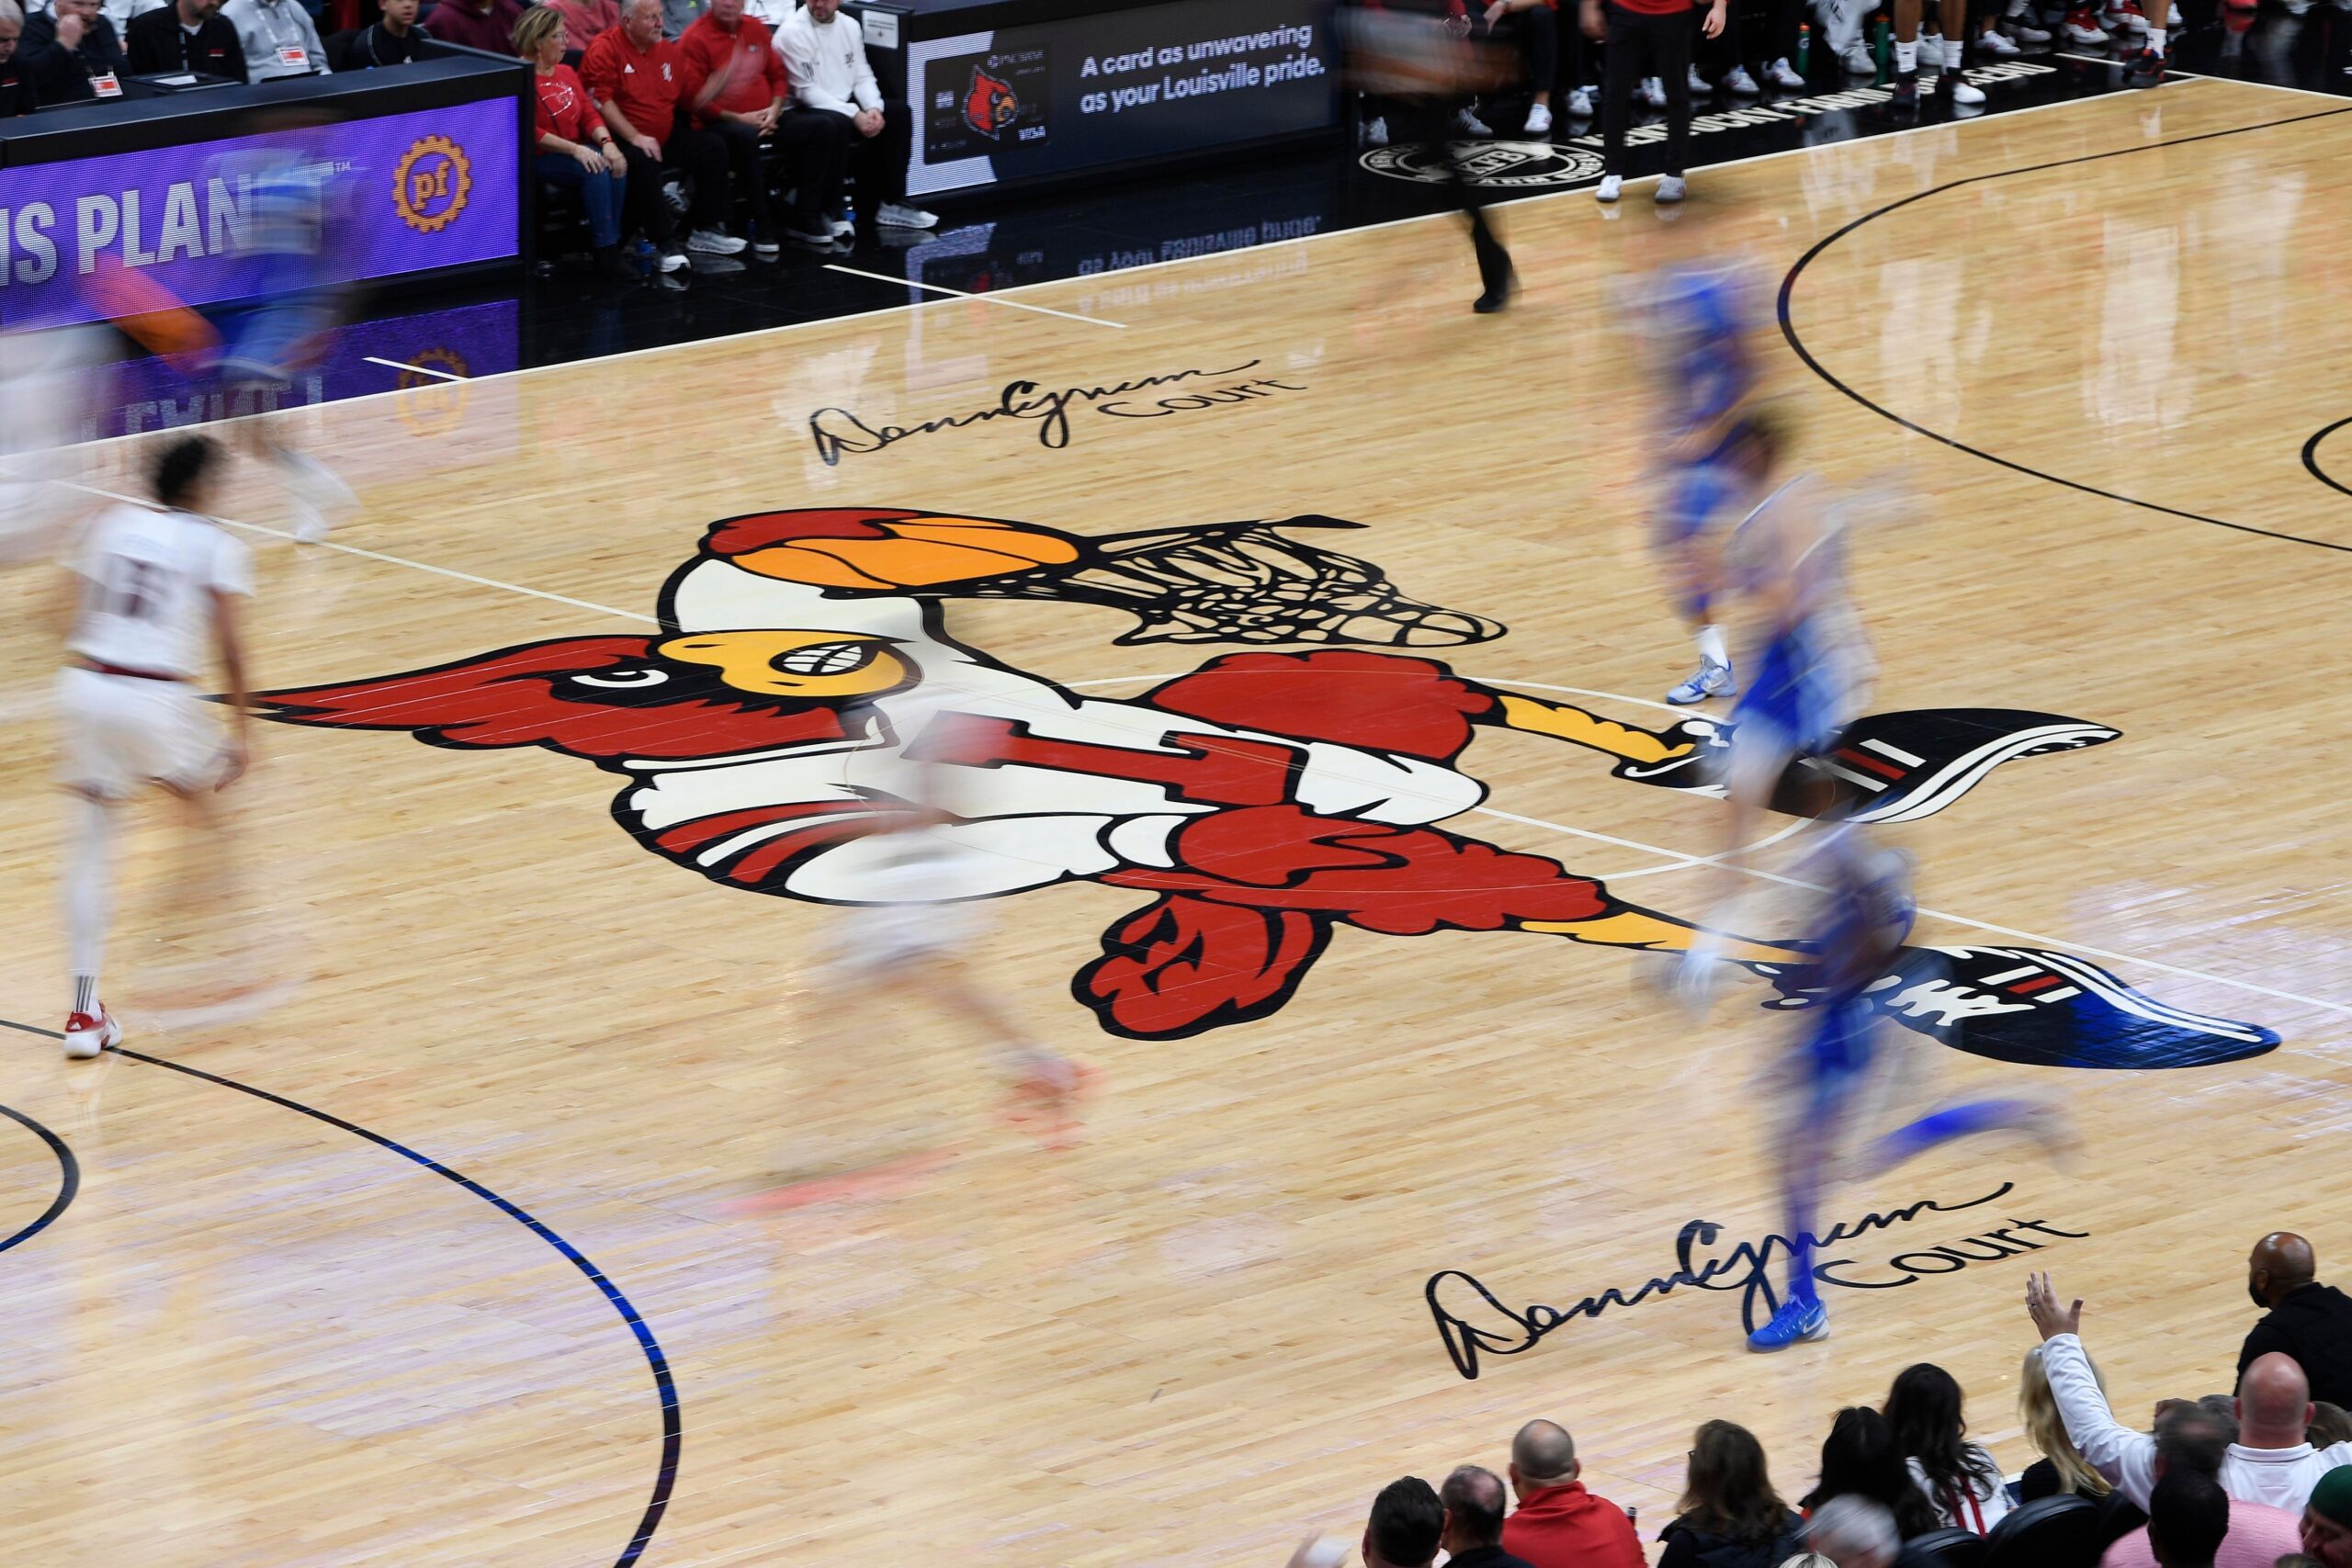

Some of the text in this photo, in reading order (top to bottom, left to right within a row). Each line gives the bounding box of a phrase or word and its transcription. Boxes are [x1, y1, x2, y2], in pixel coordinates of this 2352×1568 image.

[1080, 24, 1312, 77] A card as unwavering
[1080, 52, 1325, 113] as your Louisville pride.
